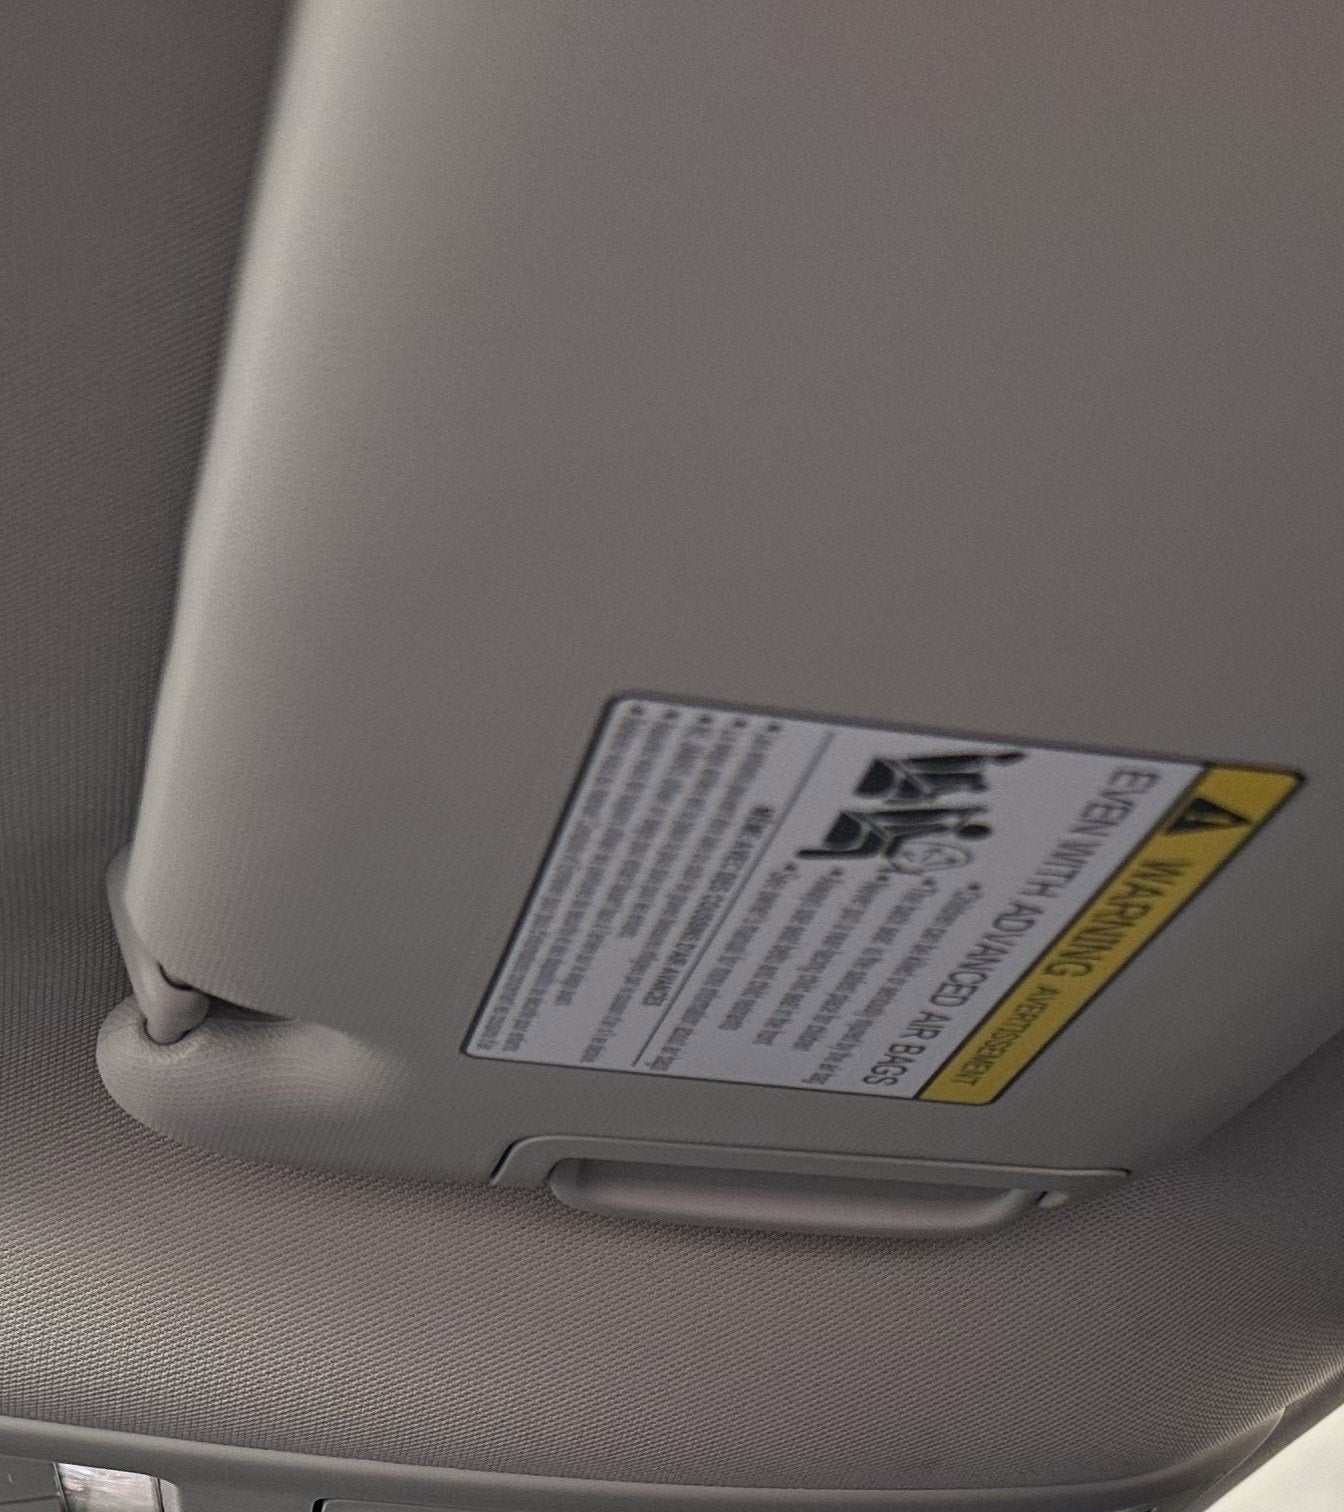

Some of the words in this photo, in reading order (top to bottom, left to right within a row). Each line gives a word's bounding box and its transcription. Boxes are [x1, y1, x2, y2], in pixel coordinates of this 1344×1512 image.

[1064, 769, 1161, 837] EVEN
[1015, 839, 1102, 898] WITH
[1038, 858, 1193, 979] WARNING
[924, 902, 1048, 1008] ADVANCED
[897, 1011, 955, 1040] AIR
[945, 985, 1065, 1087] AVERTISSEMENT
[858, 1042, 928, 1086] BAGS
